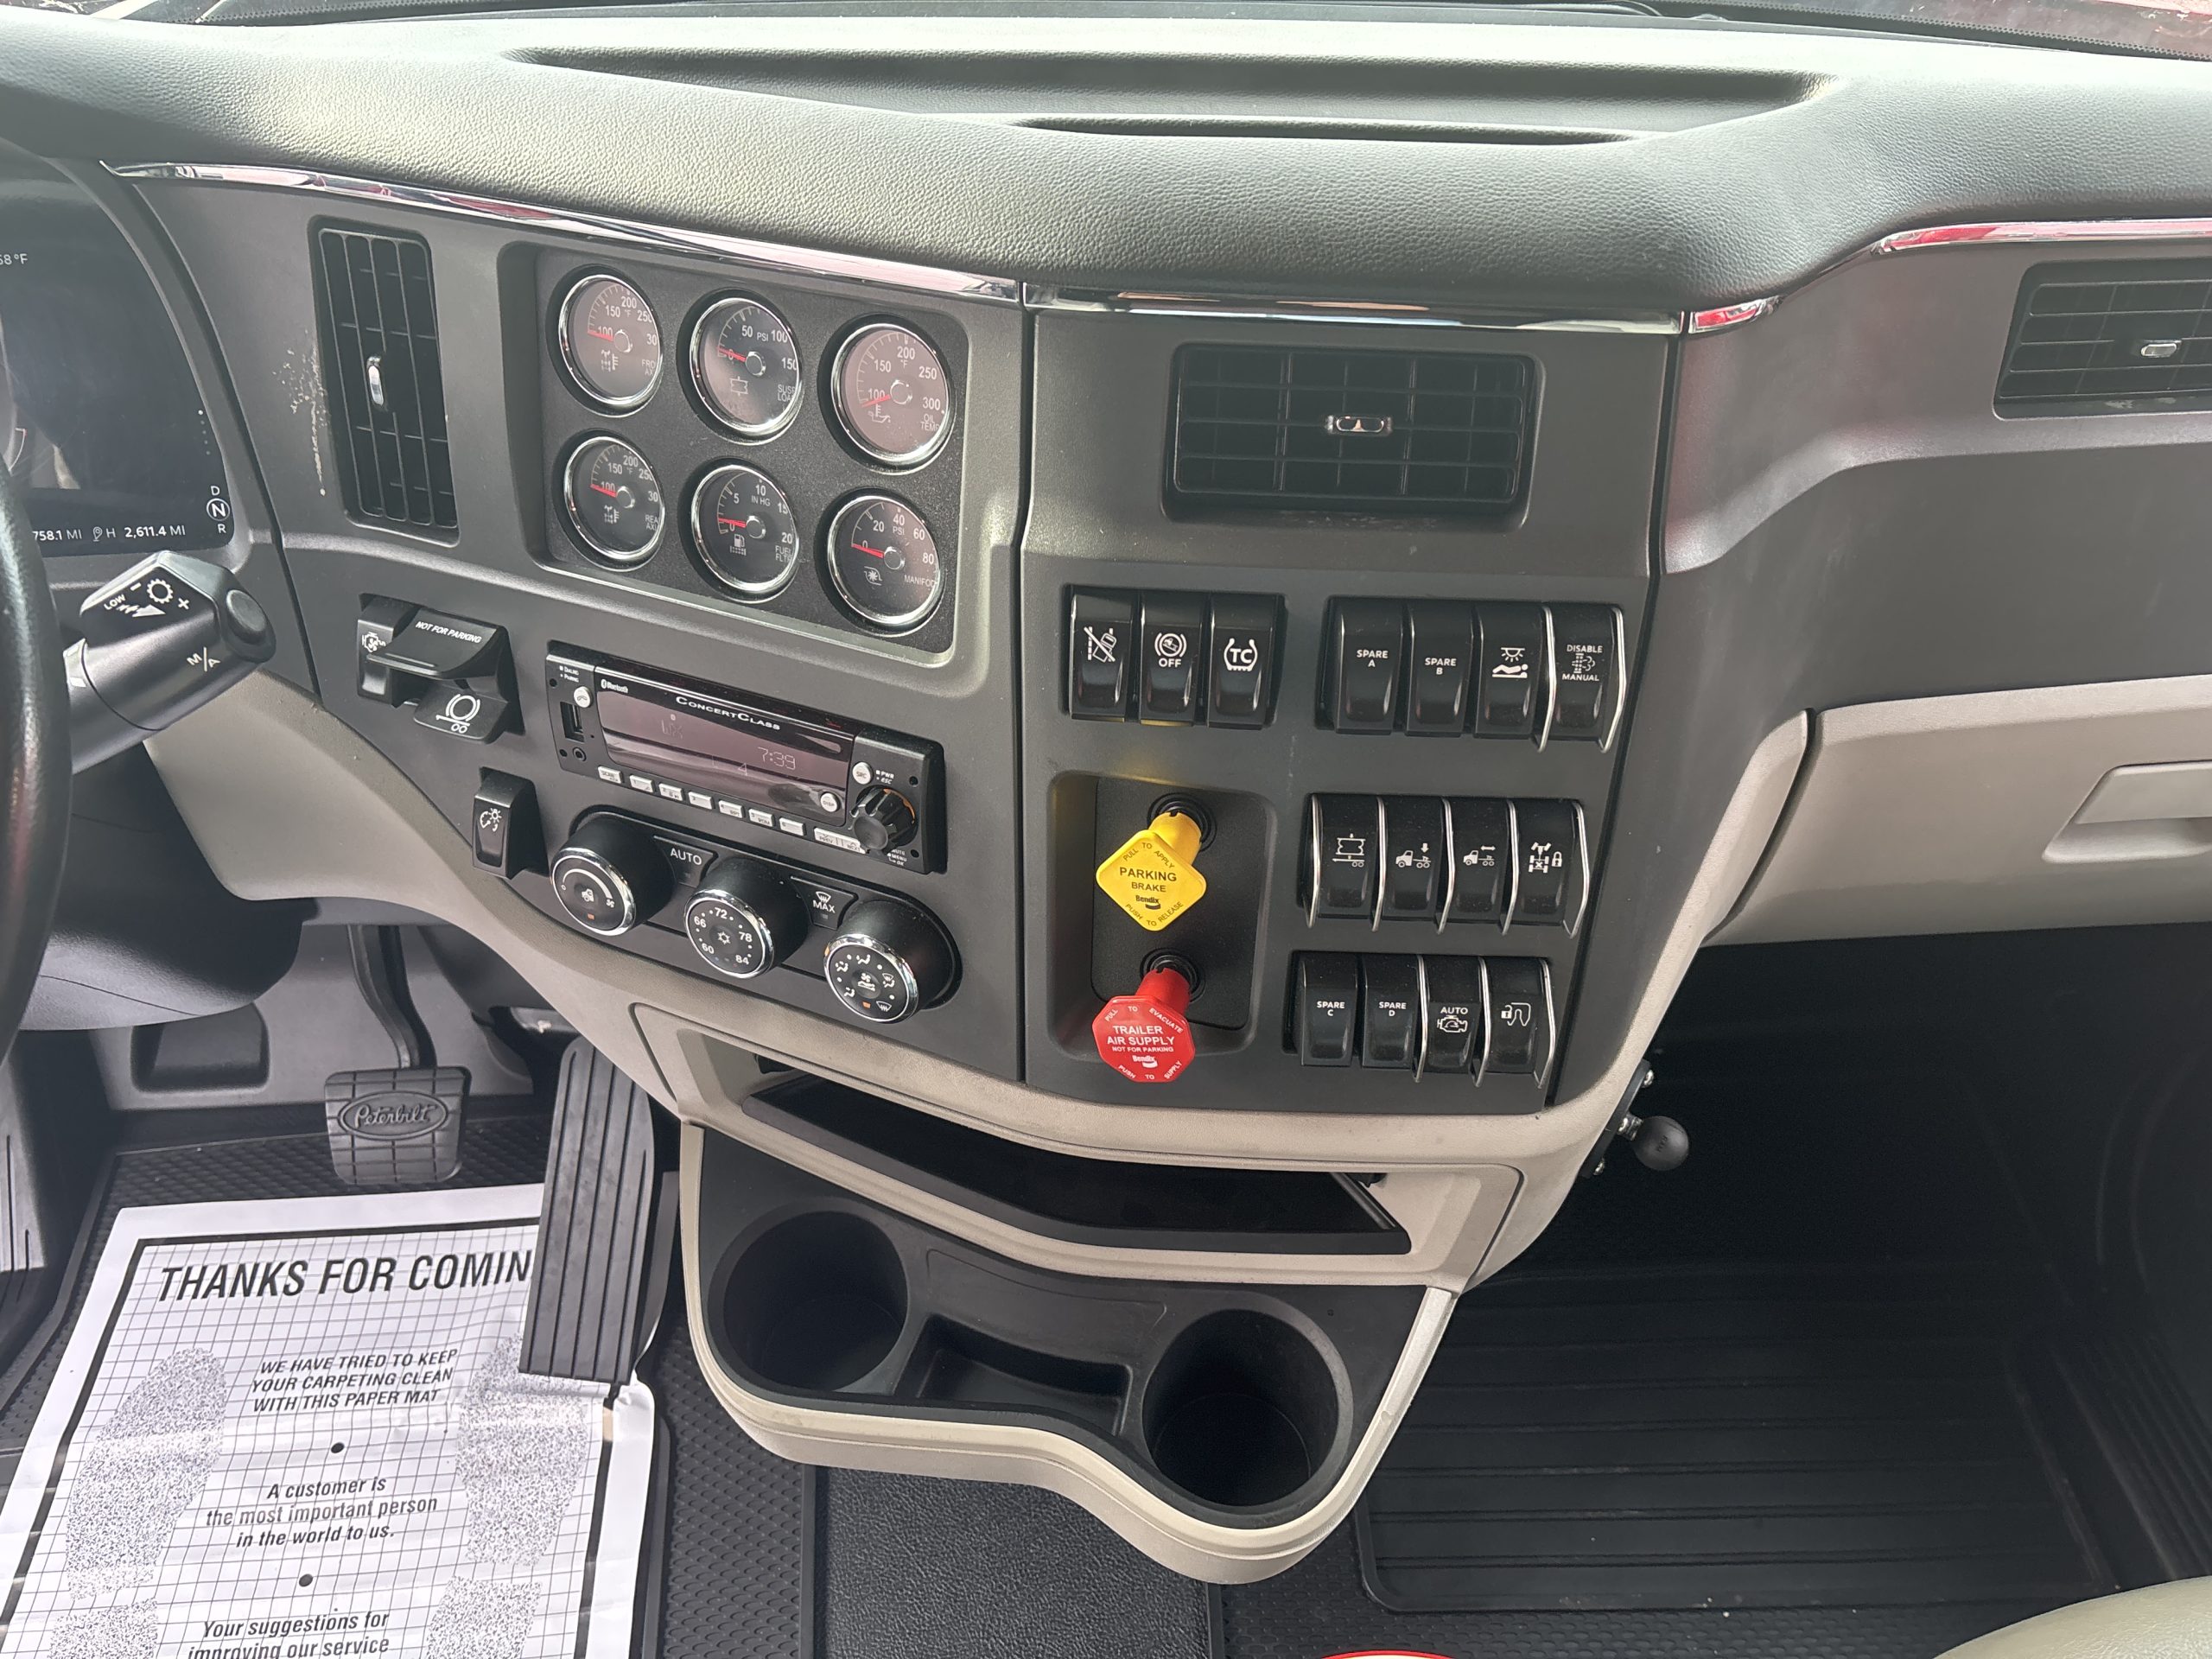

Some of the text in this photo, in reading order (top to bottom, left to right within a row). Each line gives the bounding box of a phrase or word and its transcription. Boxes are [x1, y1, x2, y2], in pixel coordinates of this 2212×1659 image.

[620, 296, 637, 309] 200
[605, 305, 620, 318] 150
[741, 325, 753, 338] 50
[757, 332, 769, 342] PSI
[771, 330, 788, 343] 100
[646, 334, 658, 346] 30
[897, 346, 916, 360] 200
[641, 359, 657, 370] FRO
[874, 359, 892, 373] 150
[918, 366, 937, 380] 250
[922, 397, 940, 411] 300
[923, 413, 935, 423] OIL
[623, 454, 639, 467] 200
[608, 463, 622, 474] 150
[211, 486, 220, 496] D
[755, 484, 766, 496] 10
[648, 491, 658, 503] 30
[733, 493, 740, 504] 5
[751, 496, 771, 506] IN HG
[873, 520, 885, 532] 20
[893, 513, 906, 526] 40
[66, 529, 83, 541] MI
[124, 527, 167, 539] 2,611.4
[169, 525, 186, 536] MI
[218, 524, 226, 534] R
[892, 525, 905, 536] PSI
[912, 527, 925, 541] 60
[781, 532, 793, 544] 20
[922, 551, 934, 565] 80
[104, 594, 126, 610] LOW
[415, 620, 482, 644] NOT FOR PARKING
[1357, 649, 1389, 658] SPARE
[1566, 645, 1603, 653] DISABLE
[1229, 648, 1253, 664] TC
[1367, 658, 1376, 667] A
[1424, 657, 1457, 667] SPARE
[1158, 658, 1182, 668] OFF
[757, 747, 797, 771] 7:39
[880, 771, 894, 779] PWR
[671, 848, 702, 866] AUTO
[1123, 849, 1139, 861] PULL
[1154, 850, 1175, 869] APPLY
[1119, 866, 1177, 882] PARKING
[1131, 881, 1166, 892] BRAKE
[1135, 895, 1160, 904] Bendix
[714, 907, 728, 919] 72
[812, 900, 836, 913] MAX
[1125, 904, 1144, 920] PUSH
[1158, 900, 1184, 923] RELEASE
[693, 916, 707, 928] 66
[738, 931, 753, 943] 78
[702, 943, 715, 954] 60
[734, 954, 750, 964] 84
[1317, 1001, 1345, 1009] SPARE
[1379, 1001, 1407, 1010] SPARE
[1104, 1008, 1118, 1021] PULL
[1149, 1007, 1184, 1033] EVACUATE
[1113, 1025, 1163, 1035] TRAILER
[1107, 1036, 1175, 1046] AIR SUPPLY
[1132, 1054, 1155, 1063] Bendix
[1118, 1065, 1136, 1078] PUSH
[1163, 1060, 1182, 1079] SUPPLY
[354, 1103, 438, 1129] Peterbilt
[158, 1249, 532, 1301] THANKS FOR COMIN
[260, 1348, 458, 1374] WE HAVE TRIED TO KEEP
[252, 1367, 454, 1394] YOUR CARPETING CLEAN
[252, 1388, 442, 1413] WITH THIS PAPER MAT
[266, 1476, 387, 1499] A customer is
[206, 1497, 439, 1527] the most important person
[237, 1526, 396, 1548] in the world to us.
[203, 1611, 390, 1638] Your suggestions for
[287, 1642, 318, 1659] our
[323, 1637, 390, 1657] service
